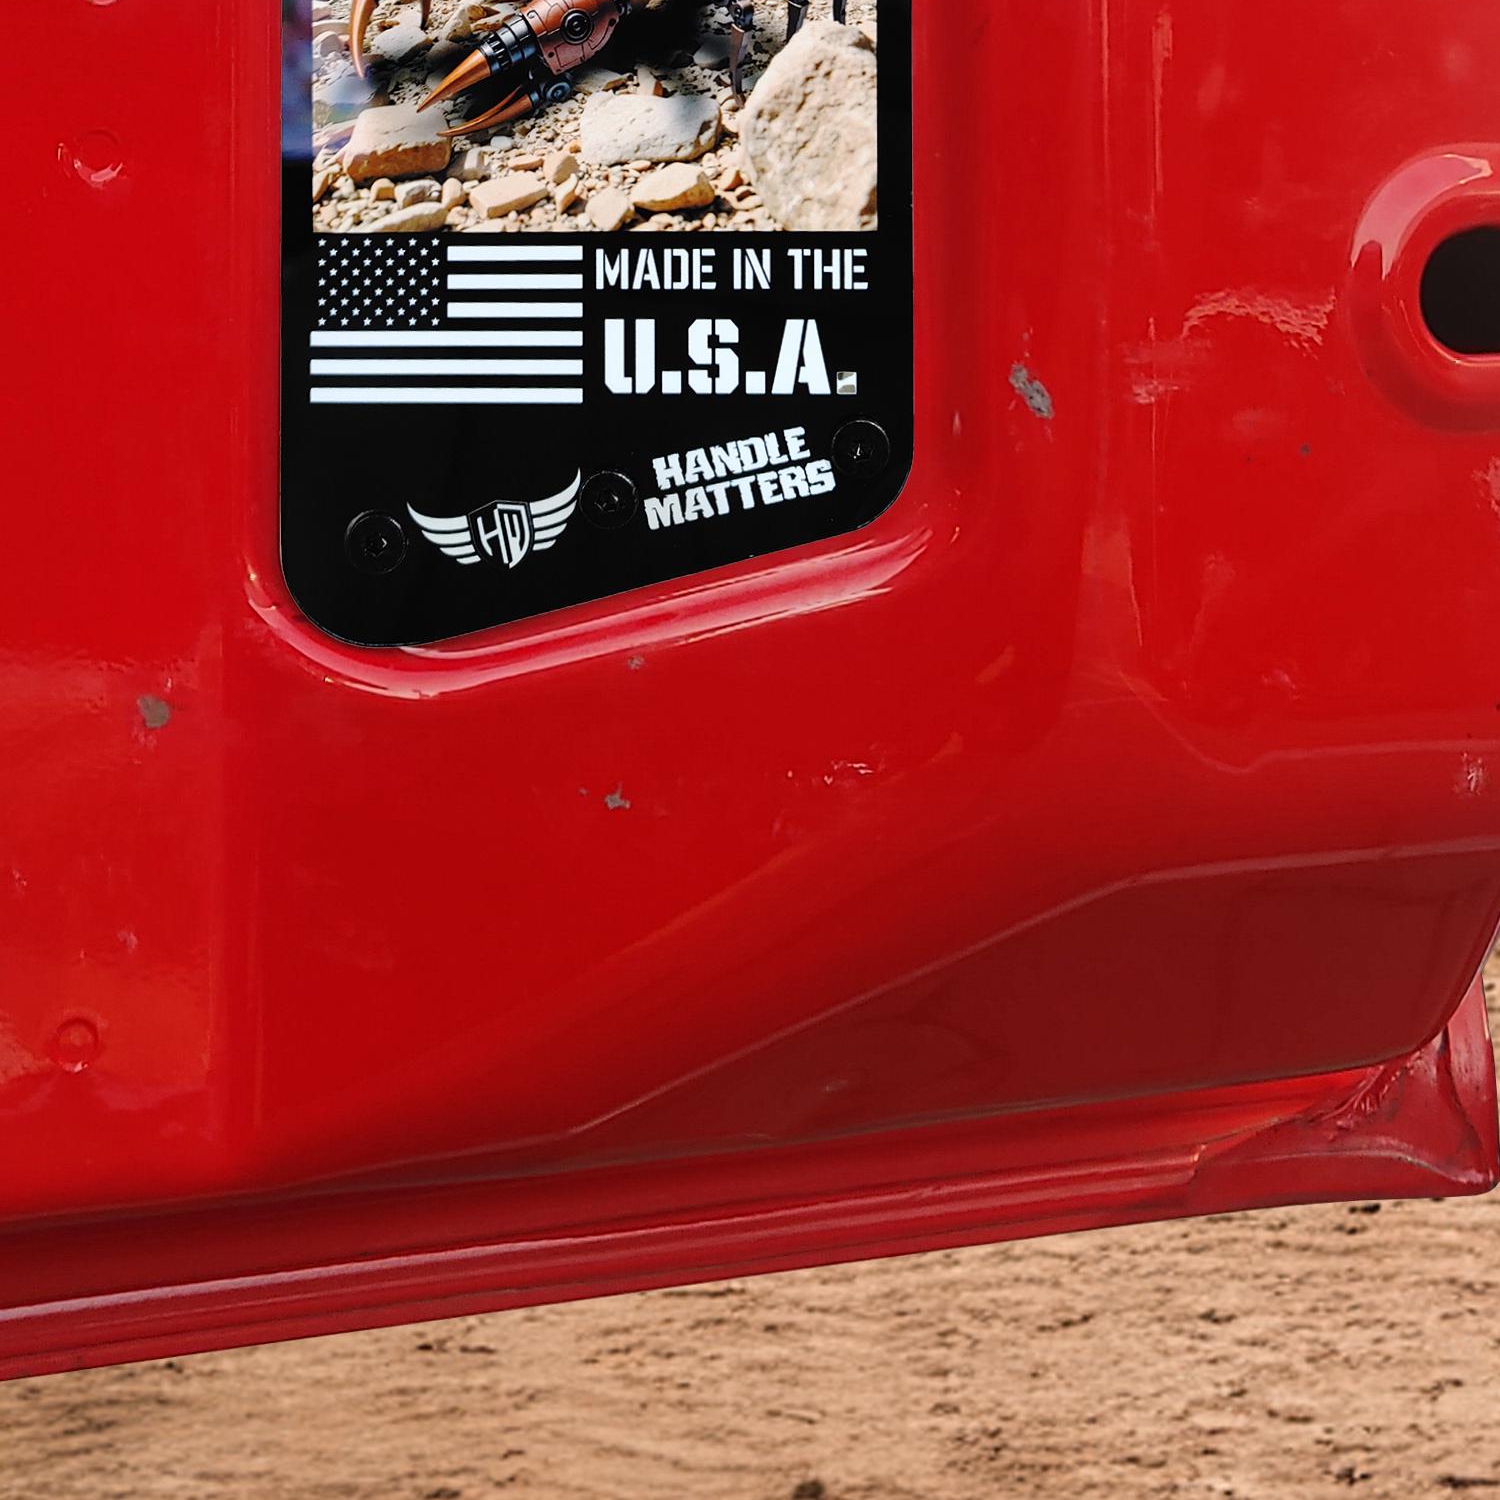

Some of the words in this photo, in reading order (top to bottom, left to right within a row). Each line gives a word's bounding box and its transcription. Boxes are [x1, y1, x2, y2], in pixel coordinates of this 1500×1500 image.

[596, 248, 716, 290] MADE
[734, 248, 771, 290] IN
[788, 248, 869, 290] THE
[605, 319, 858, 395] U.S.A.
[653, 427, 810, 490] HANDLE
[644, 459, 836, 530] MATTERS
